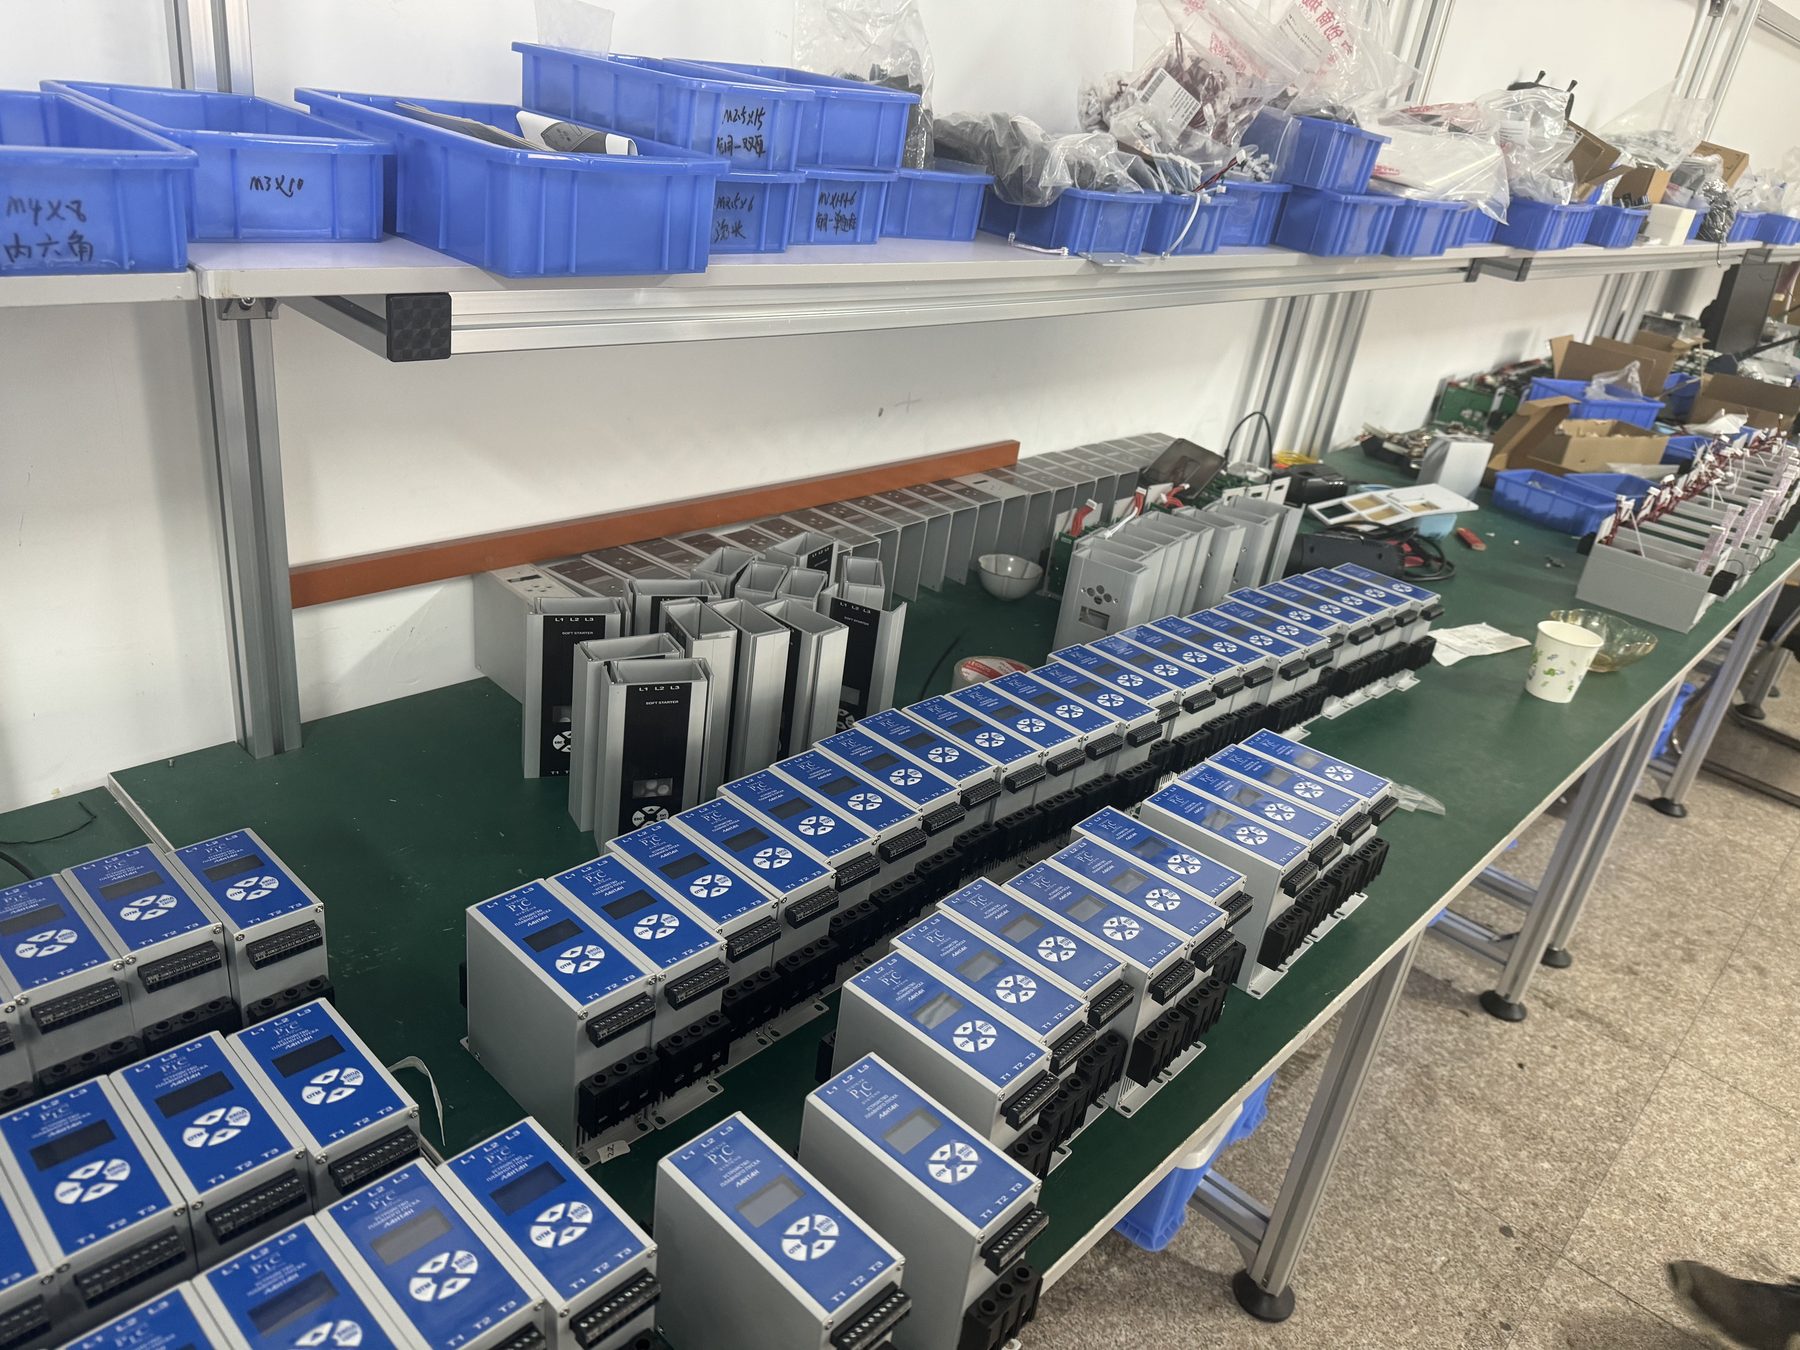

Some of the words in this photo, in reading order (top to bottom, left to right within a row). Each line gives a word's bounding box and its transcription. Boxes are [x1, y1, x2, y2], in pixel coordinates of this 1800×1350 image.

[3, 230, 94, 264] 内六角
[605, 983, 618, 991] T2
[861, 975, 871, 983] L1
[874, 966, 885, 974] L2
[887, 958, 897, 966] L3
[251, 1027, 265, 1035] L1
[274, 1017, 289, 1026] L2
[297, 1009, 311, 1017] L3
[135, 1064, 150, 1073] L1
[161, 1053, 177, 1062] L2
[186, 1043, 202, 1052] L3
[1013, 1062, 1024, 1070] T2
[1025, 1052, 1036, 1060] T3
[826, 1086, 838, 1095] L1
[842, 1075, 854, 1084] L2
[857, 1064, 869, 1073] L3
[330, 1129, 345, 1138] T1
[354, 1117, 370, 1126] T2
[377, 1106, 393, 1115] T3
[460, 1154, 475, 1165] L1
[483, 1142, 499, 1152] L2
[505, 1130, 520, 1140] L3
[681, 1150, 695, 1160] L1
[701, 1138, 715, 1148] L2
[720, 1126, 733, 1136] L3
[209, 1174, 225, 1184] T1
[236, 1161, 252, 1171] T2
[262, 1148, 279, 1158] T3
[342, 1200, 358, 1211] L1
[368, 1186, 384, 1197] L2
[393, 1173, 409, 1184] L3
[980, 1209, 993, 1218] T1
[995, 1195, 1008, 1205] T2
[1010, 1183, 1023, 1192] T3
[570, 1278, 586, 1288] T1
[593, 1262, 609, 1273] T2
[616, 1248, 632, 1258] T3
[831, 1291, 846, 1301] T1
[850, 1275, 865, 1286] T2
[869, 1261, 883, 1272] T3
[447, 1334, 464, 1346] T1
[474, 1317, 491, 1329] T2
[499, 1301, 516, 1312] T3
